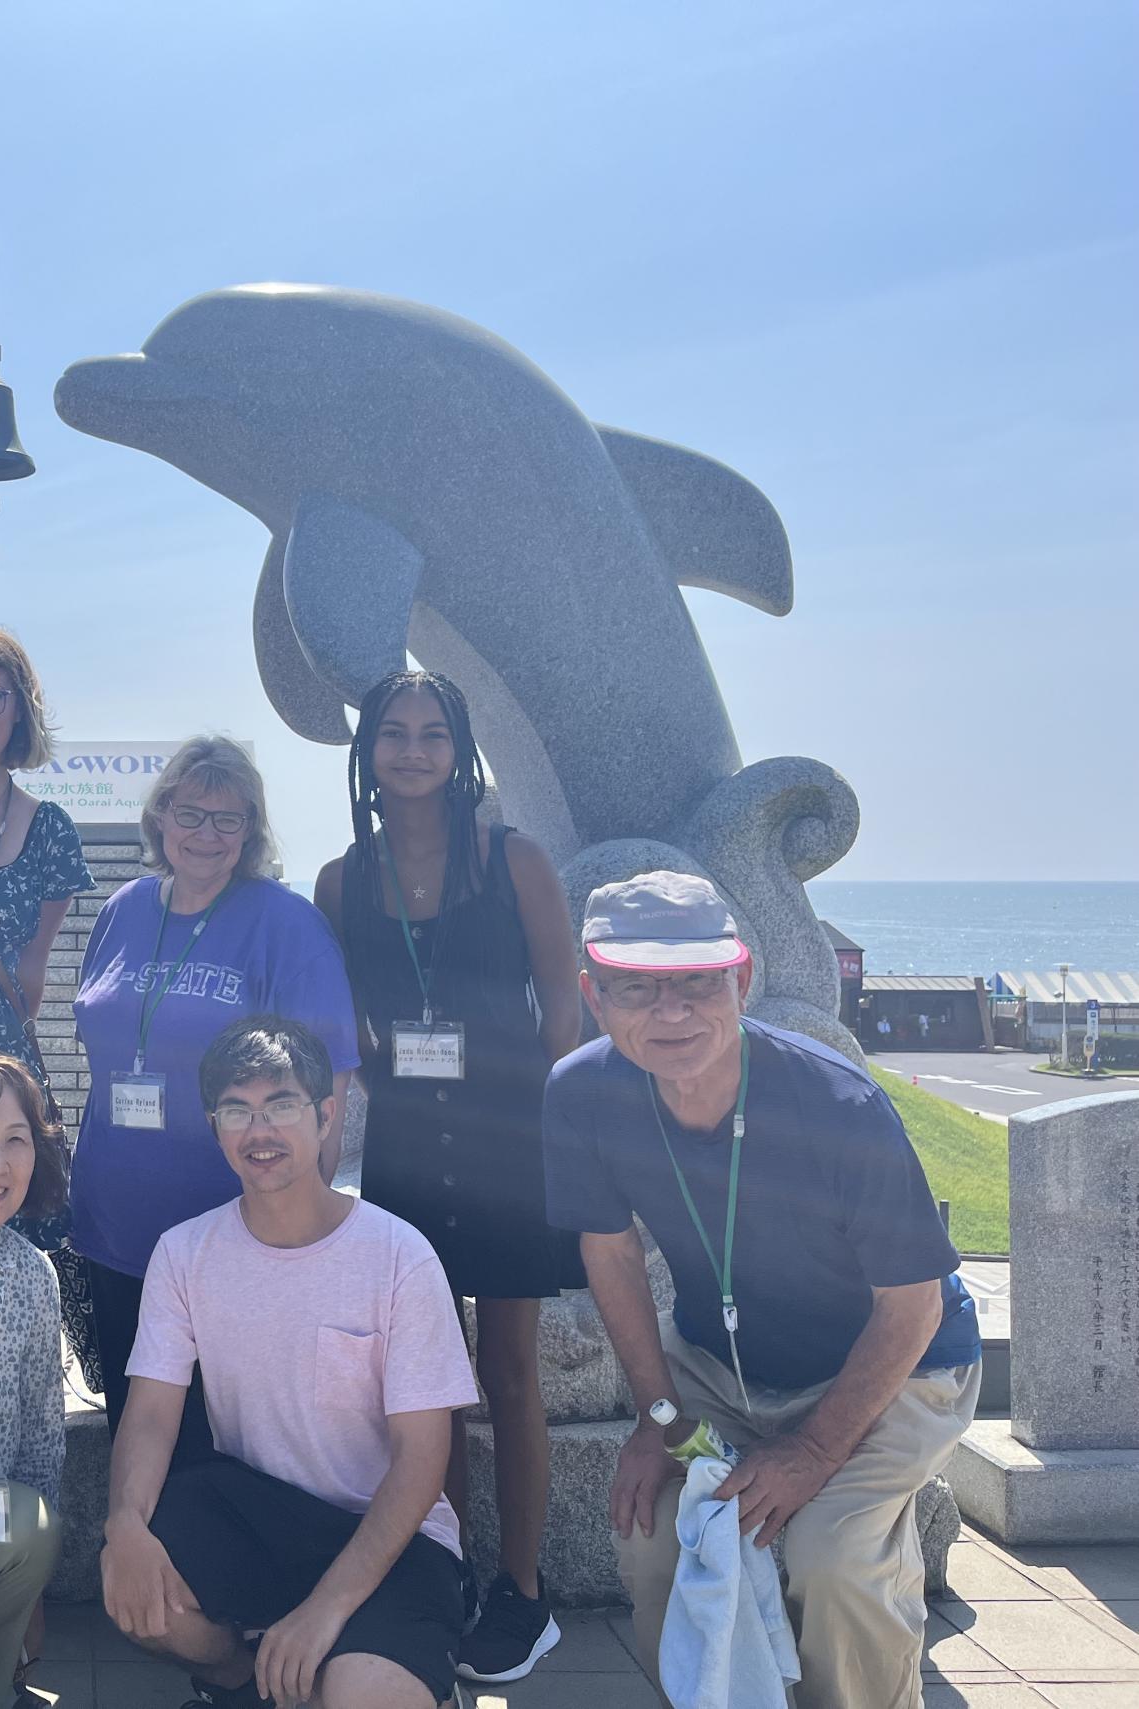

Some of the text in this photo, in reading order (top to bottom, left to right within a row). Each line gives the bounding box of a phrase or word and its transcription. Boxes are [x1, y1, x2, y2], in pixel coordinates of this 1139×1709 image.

[67, 754, 171, 774] WOR
[22, 782, 114, 795] 大洗水族館
[78, 798, 111, 806] Oarai
[115, 798, 142, 808] Aqu
[1092, 1255, 1106, 1393] 平成十八年三月 館長
